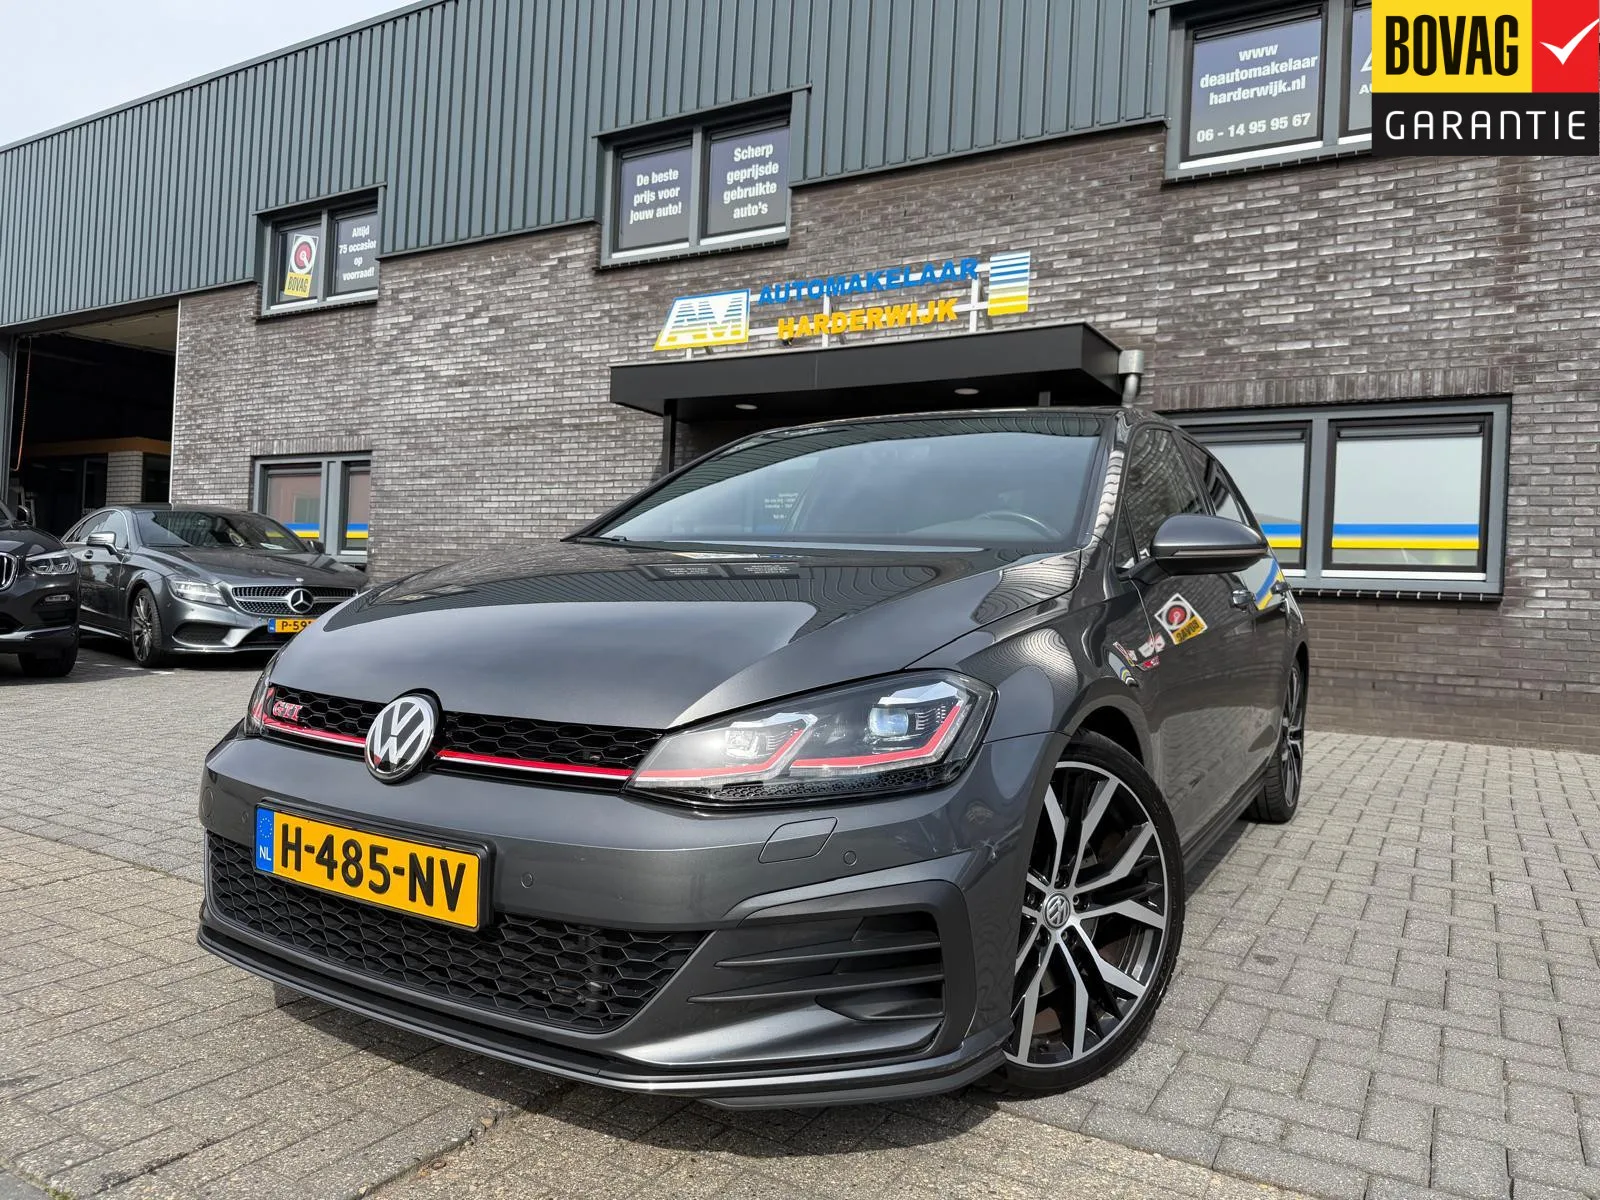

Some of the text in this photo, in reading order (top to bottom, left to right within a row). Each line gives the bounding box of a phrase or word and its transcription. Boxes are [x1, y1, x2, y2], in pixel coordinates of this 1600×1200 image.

[1238, 44, 1279, 61] www
[1200, 56, 1318, 88] deautomakelaar
[1209, 76, 1306, 105] harderwijk.nl
[1197, 130, 1214, 142] 06
[1228, 124, 1246, 138] 14
[1249, 120, 1266, 134] 95
[1271, 116, 1288, 131] 95
[1292, 112, 1311, 127] 67
[733, 144, 774, 162] Scherp
[636, 169, 679, 187] De beste
[727, 161, 779, 184] geprijsde
[634, 186, 680, 206] prijs voor
[723, 181, 777, 204] gebruikte
[656, 202, 682, 217] auto!
[733, 202, 768, 219] auto's
[352, 225, 370, 238] Altijd
[338, 244, 348, 254] 75
[354, 257, 363, 267] op
[343, 267, 375, 281] voorraad!
[758, 257, 979, 306] AUTOMAKELAAR
[287, 275, 309, 292] BOVAG
[777, 297, 959, 340] HARDERWIJK
[281, 620, 312, 631] P-59
[272, 700, 303, 722] GTI
[259, 845, 272, 861] NL
[281, 823, 466, 912] H-485-NV
